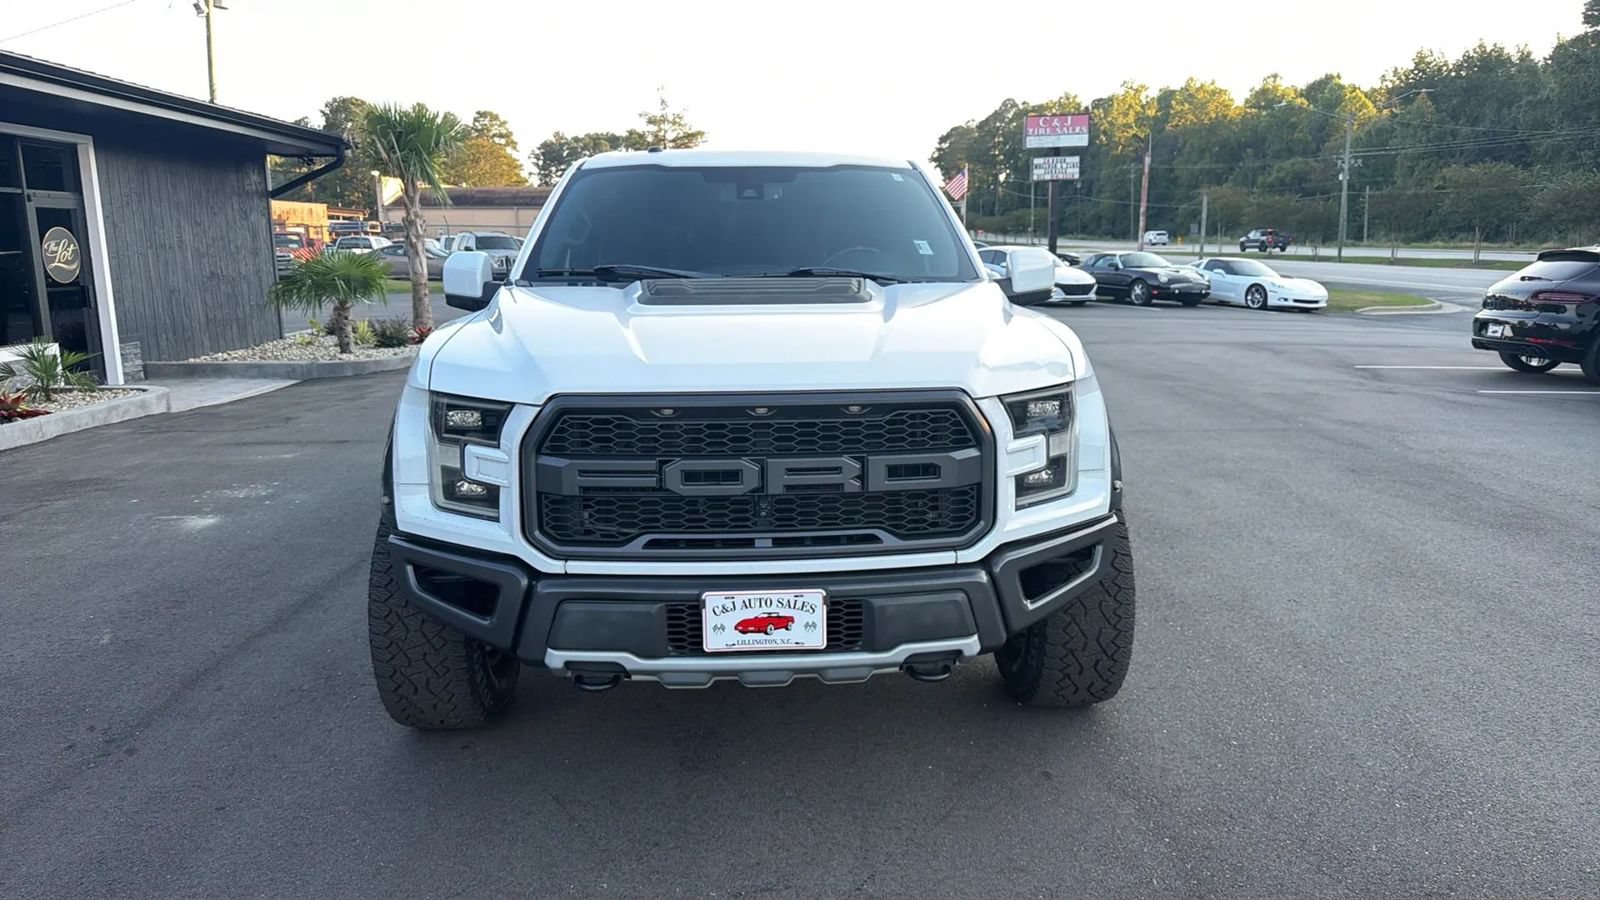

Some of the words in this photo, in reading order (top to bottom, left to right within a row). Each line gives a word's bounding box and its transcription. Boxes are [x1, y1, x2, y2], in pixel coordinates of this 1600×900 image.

[1039, 116, 1050, 128] C
[1052, 119, 1061, 127] &
[1064, 116, 1073, 126] J
[1055, 126, 1087, 134] SALES
[44, 240, 60, 256] The
[48, 239, 79, 271] Lot
[548, 451, 965, 496] FORD
[712, 600, 737, 617] C&J
[740, 597, 773, 610] AUTO
[776, 597, 817, 615] SALES
